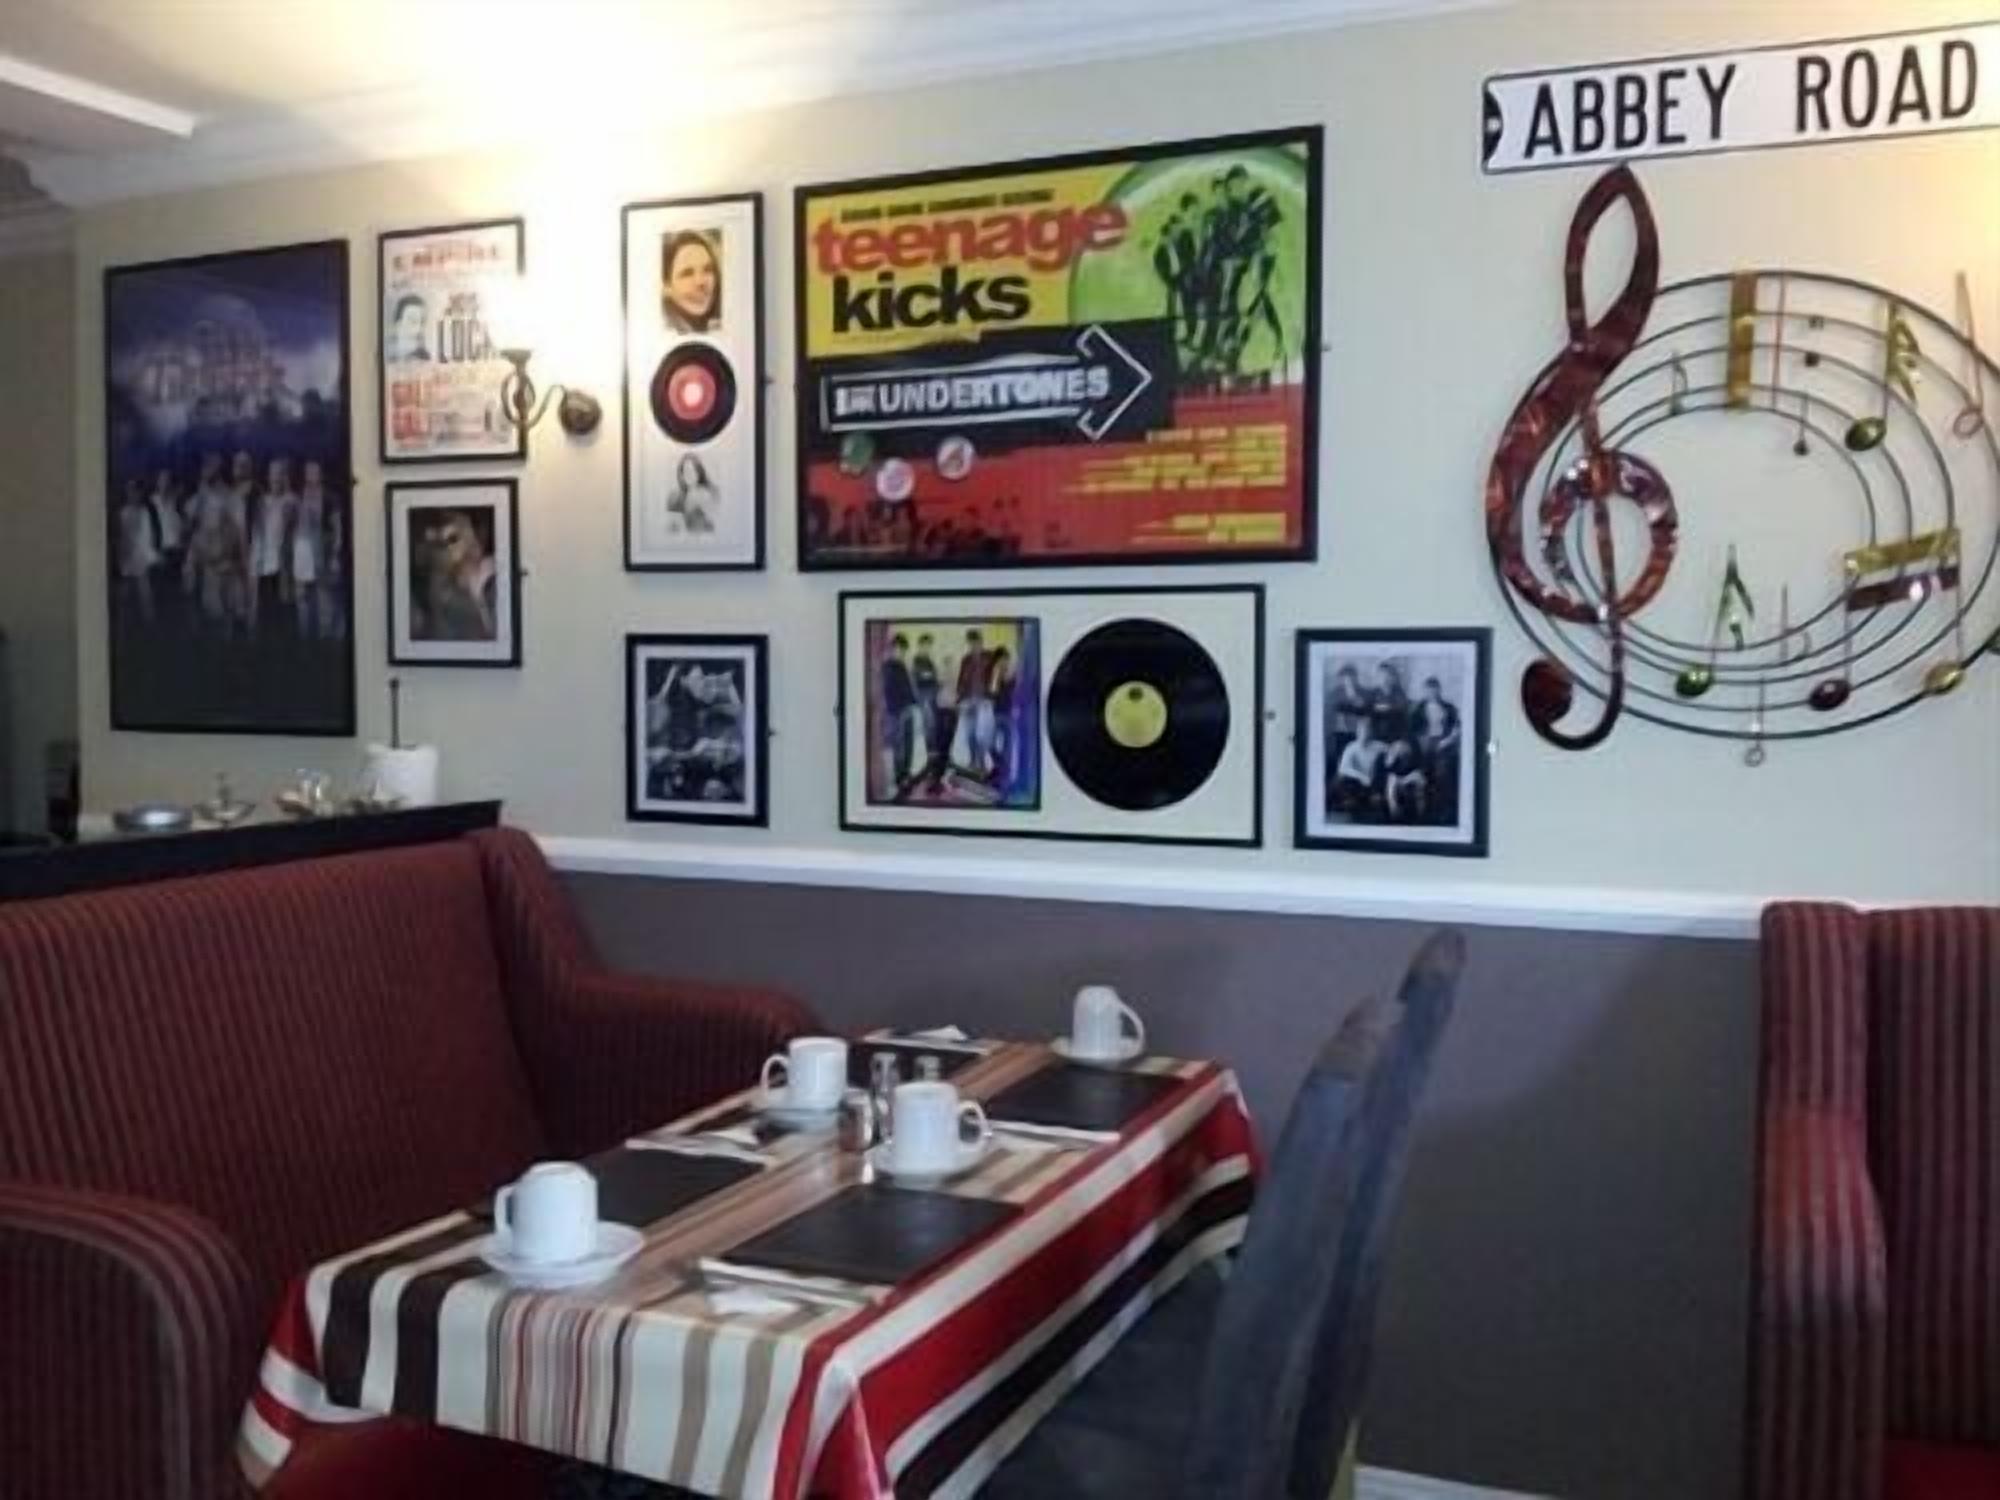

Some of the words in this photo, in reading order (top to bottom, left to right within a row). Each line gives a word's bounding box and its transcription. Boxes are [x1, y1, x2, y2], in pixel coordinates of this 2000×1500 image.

[1523, 63, 1737, 160] ABBEY
[1795, 40, 1978, 135] ROAD
[814, 203, 1127, 273] teenage
[832, 265, 1031, 332] kicks
[880, 366, 1109, 413] UNDERTONES
